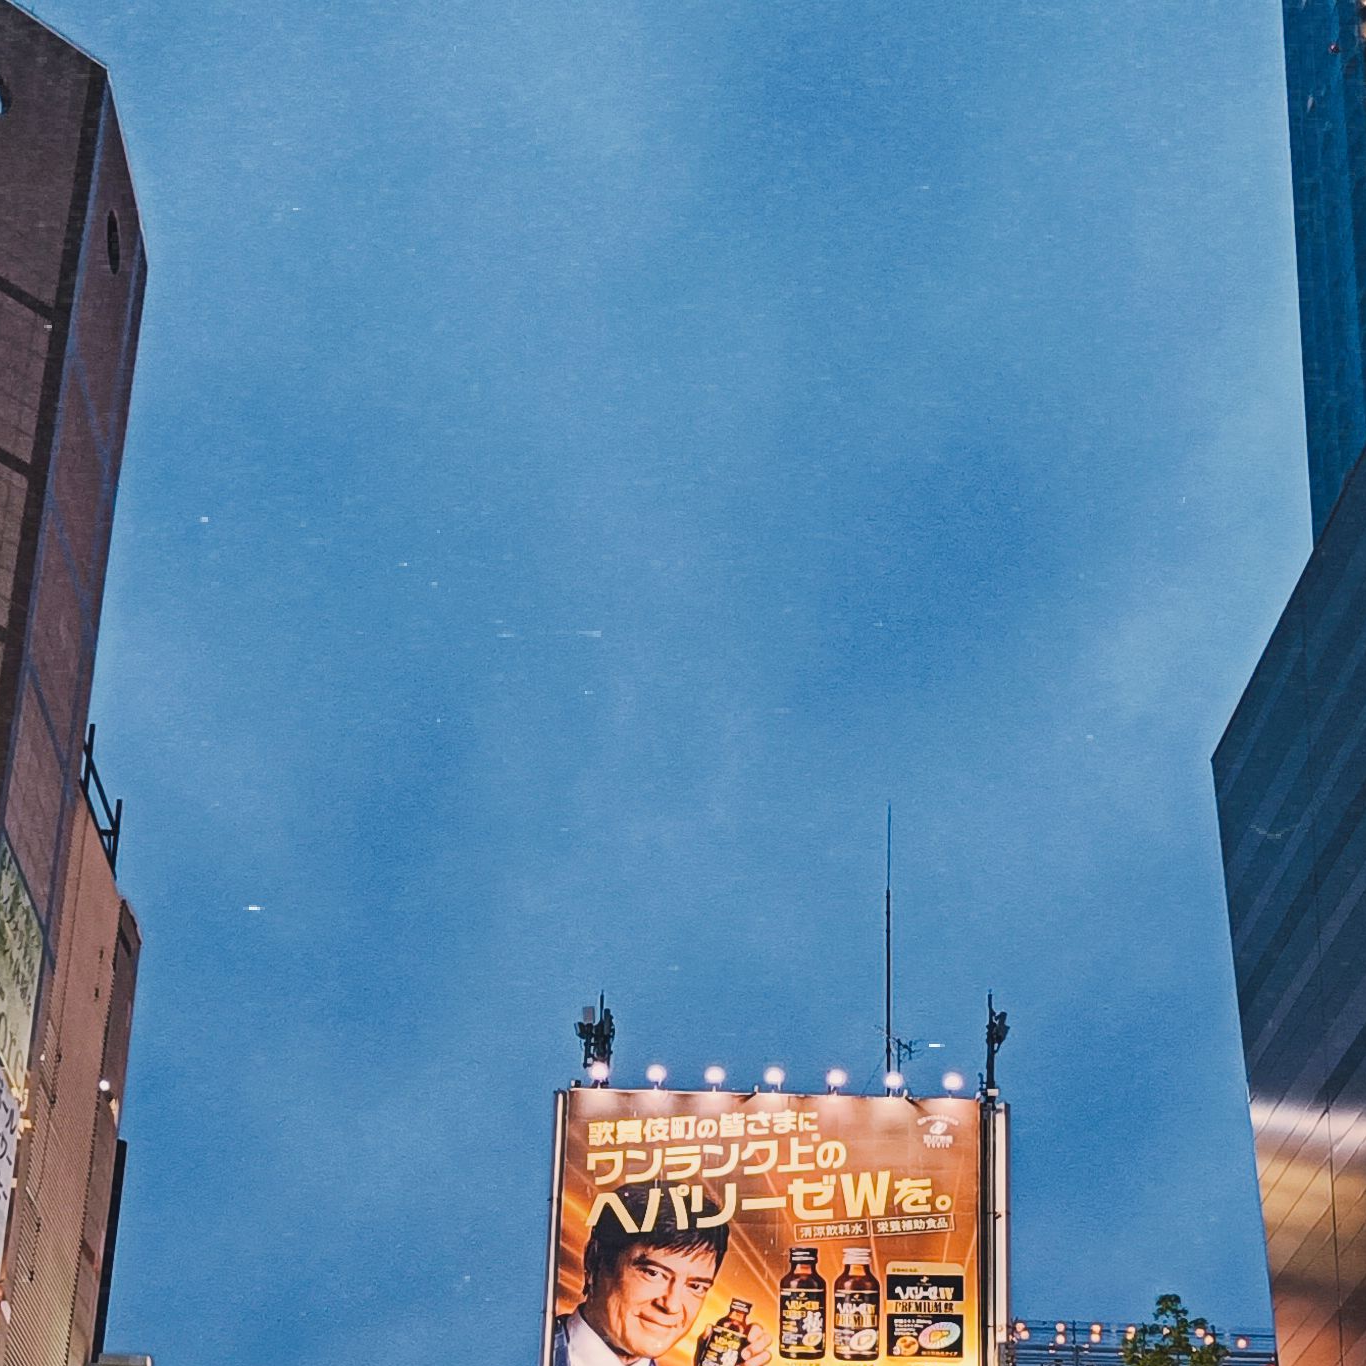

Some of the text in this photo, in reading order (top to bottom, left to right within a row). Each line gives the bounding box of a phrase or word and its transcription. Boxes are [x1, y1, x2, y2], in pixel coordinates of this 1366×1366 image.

[586, 1139, 847, 1185] ワンランク上の
[585, 1171, 953, 1234] ヘパリーゼWを。
[798, 1217, 949, 1238] 清涼飲料水 栄養補助食品
[894, 1301, 942, 1314] PREMIUM
